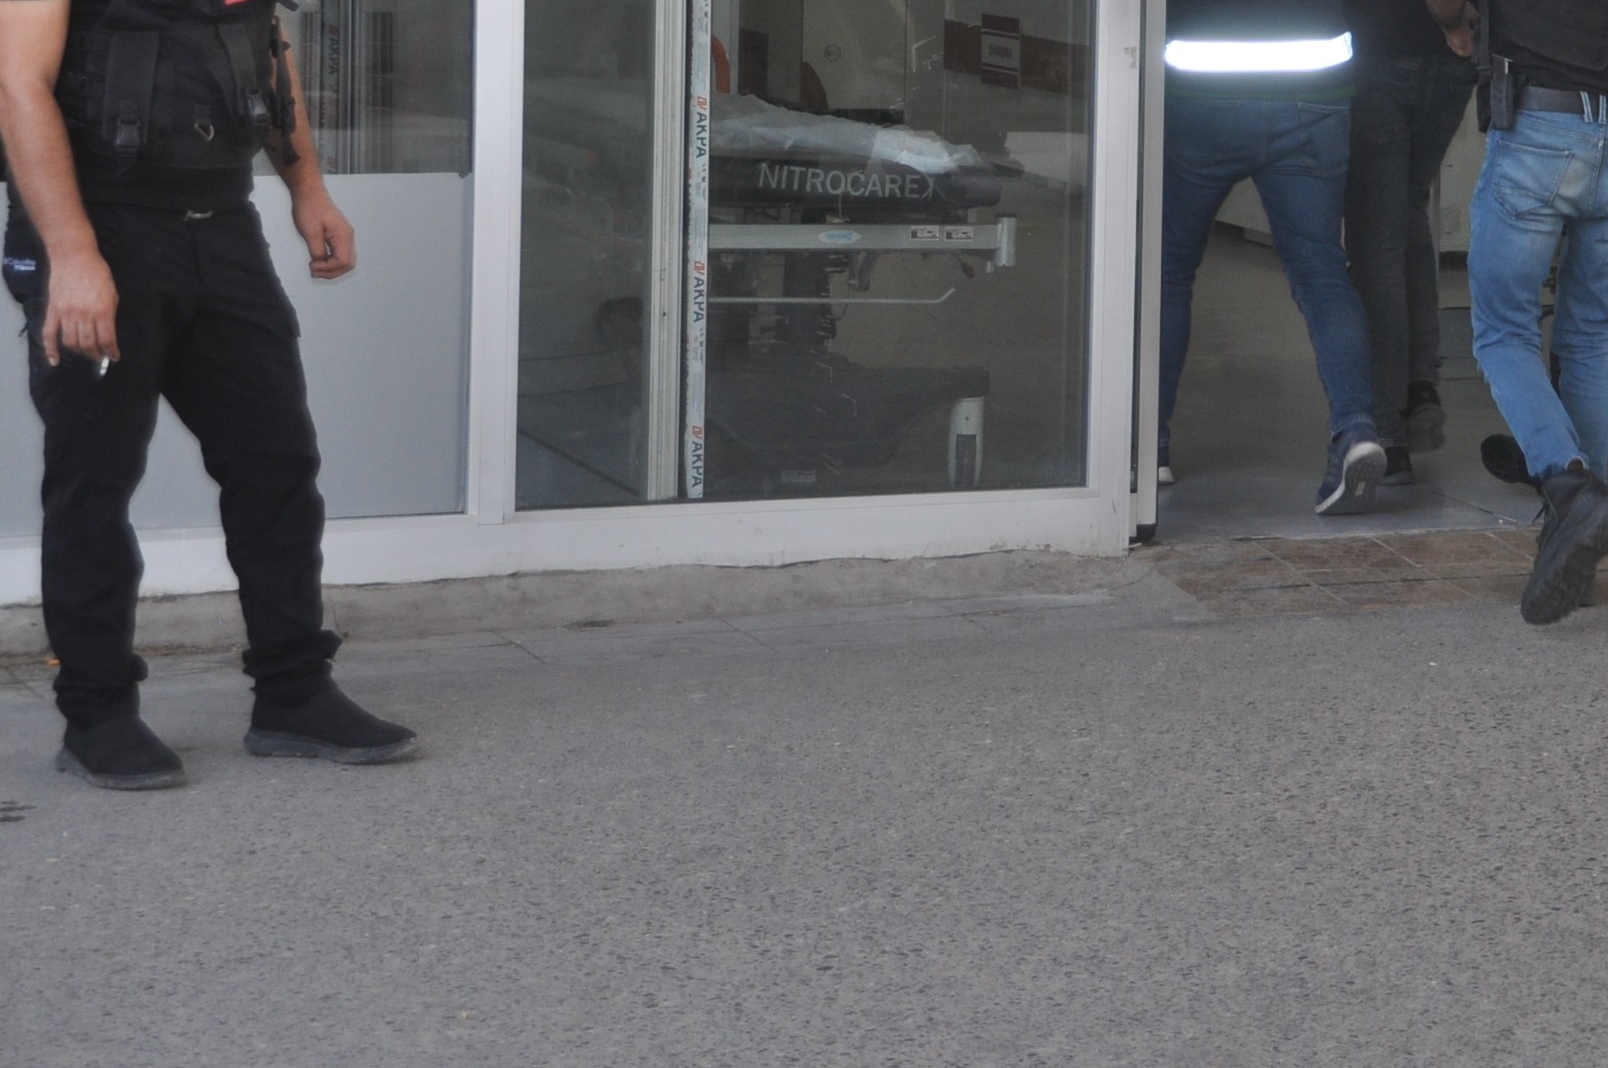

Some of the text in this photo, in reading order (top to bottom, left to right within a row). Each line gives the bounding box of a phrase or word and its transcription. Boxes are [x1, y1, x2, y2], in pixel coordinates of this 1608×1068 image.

[696, 112, 707, 159] AKPA
[758, 162, 922, 199] NITROCARE
[693, 276, 705, 323] AKPA
